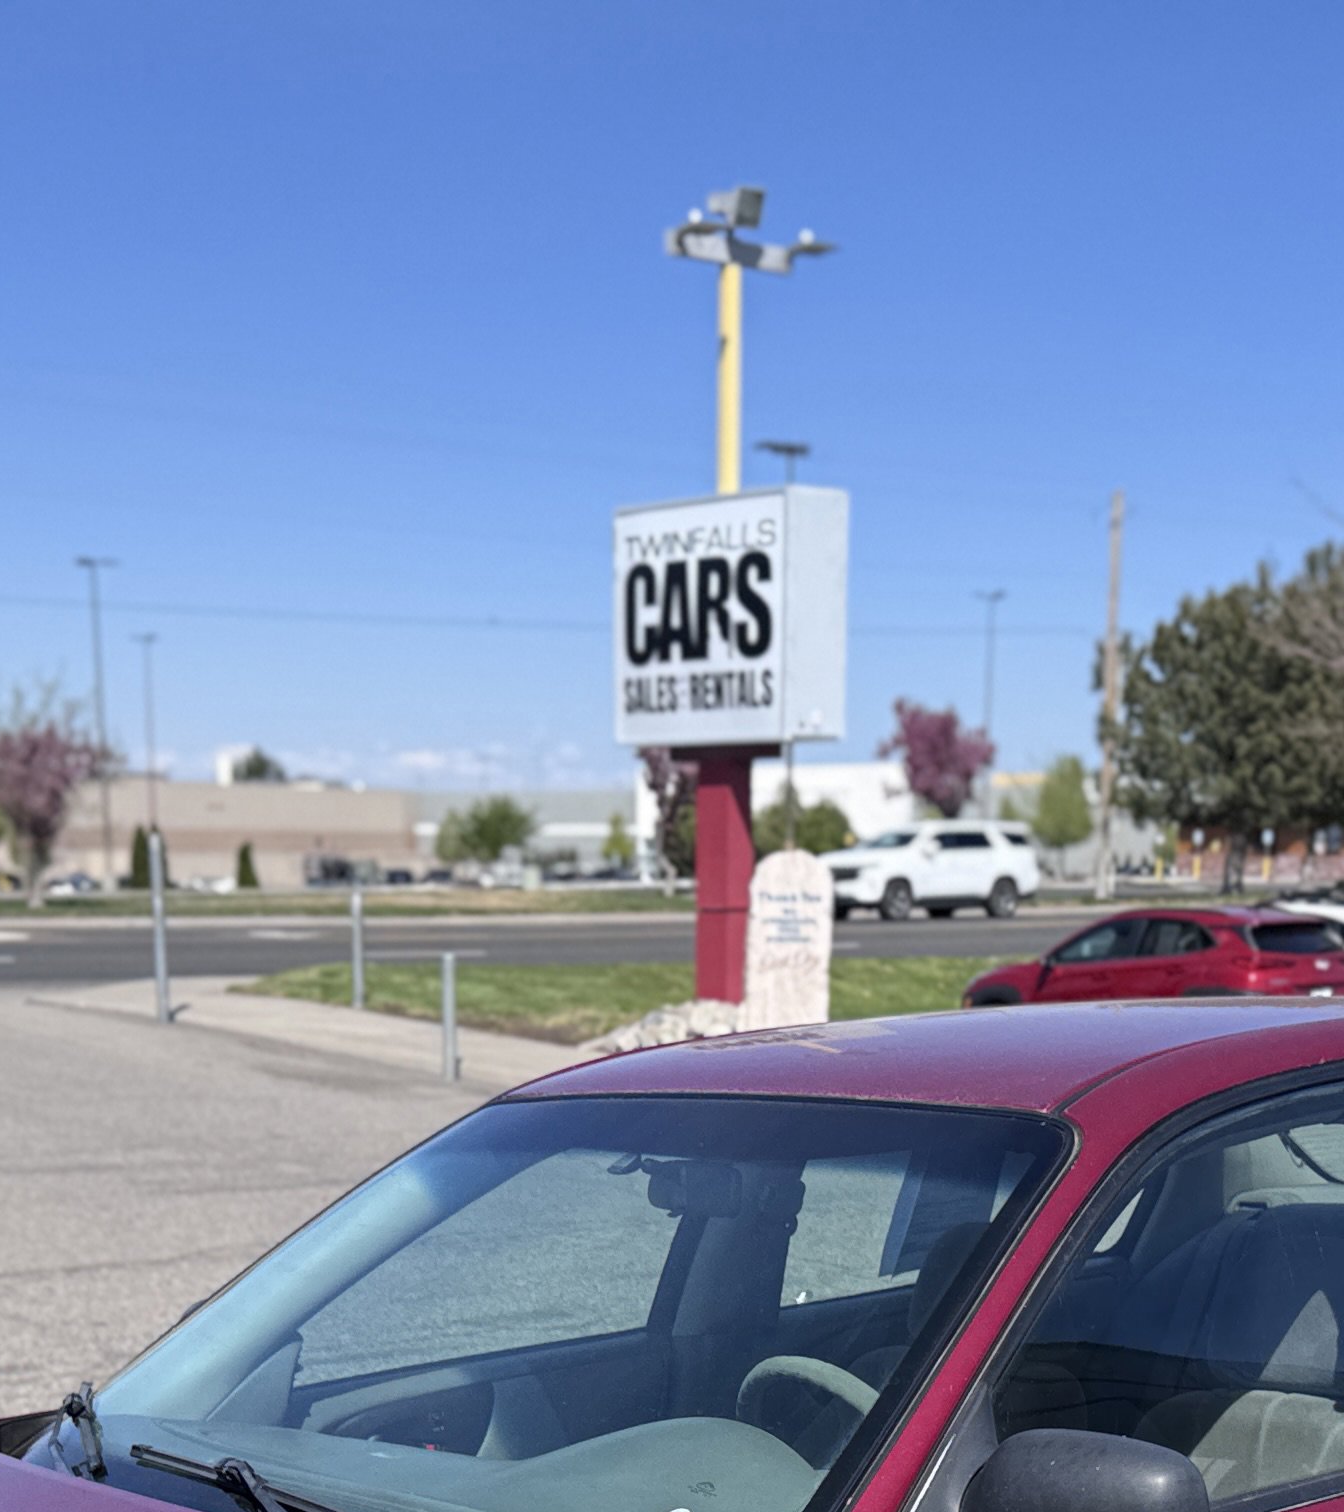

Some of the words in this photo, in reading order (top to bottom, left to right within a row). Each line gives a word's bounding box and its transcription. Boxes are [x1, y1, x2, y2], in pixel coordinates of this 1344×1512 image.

[625, 549, 772, 667] CARS
[625, 675, 677, 713] SALES
[690, 669, 773, 711] RENTALS
